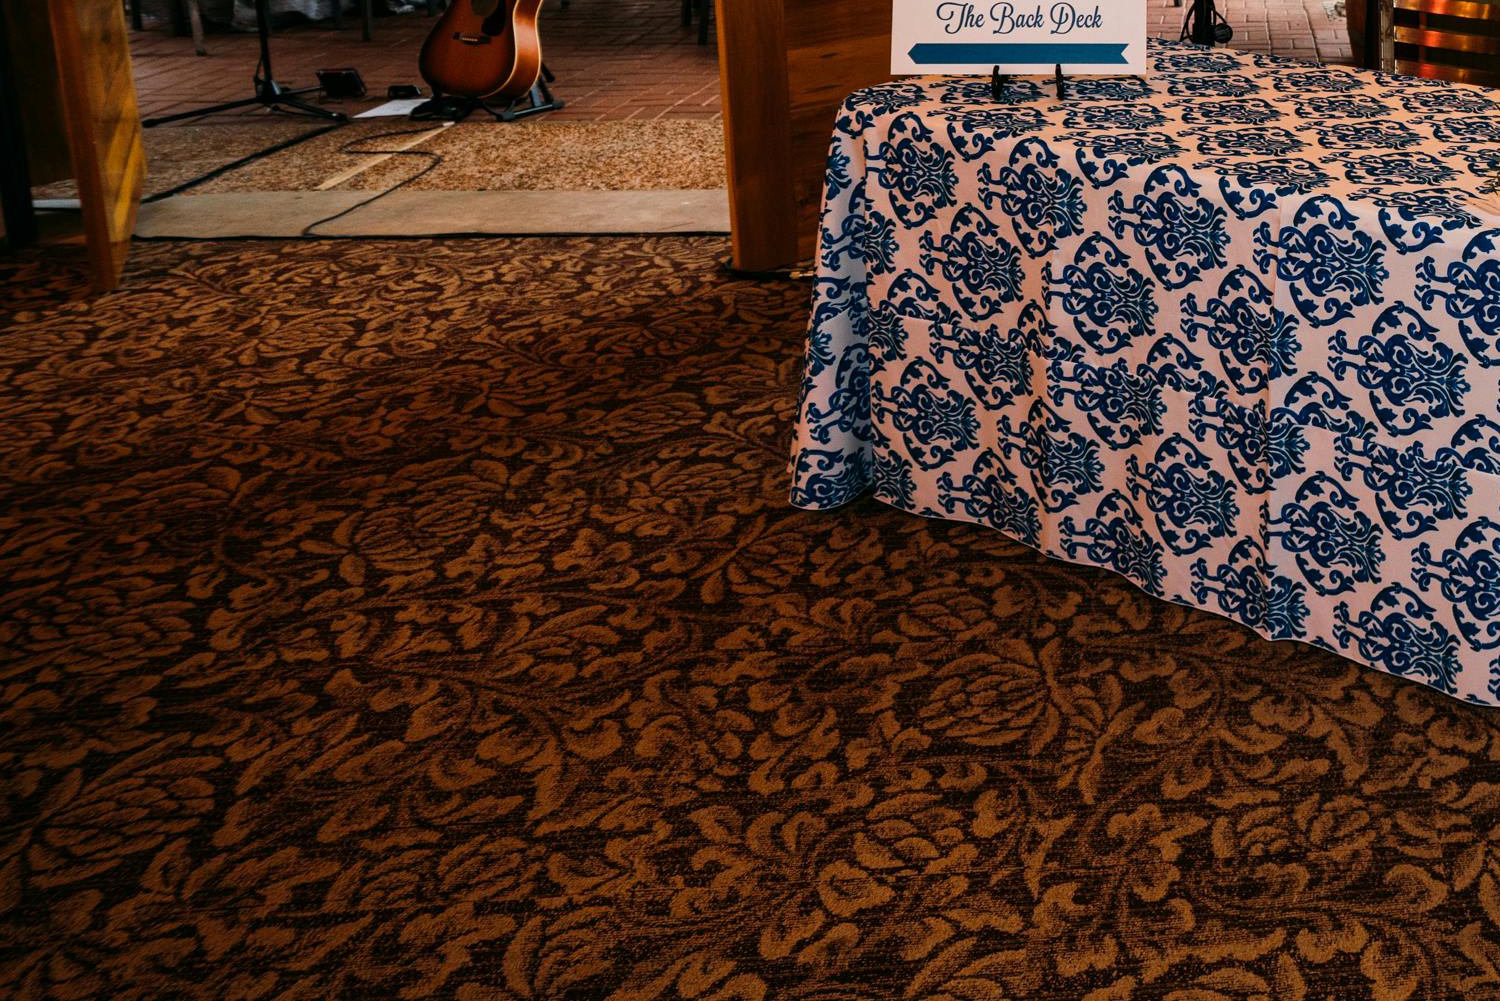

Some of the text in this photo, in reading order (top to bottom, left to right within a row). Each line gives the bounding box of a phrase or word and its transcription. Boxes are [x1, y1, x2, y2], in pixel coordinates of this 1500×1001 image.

[936, 1, 1103, 34] The Back Deck
